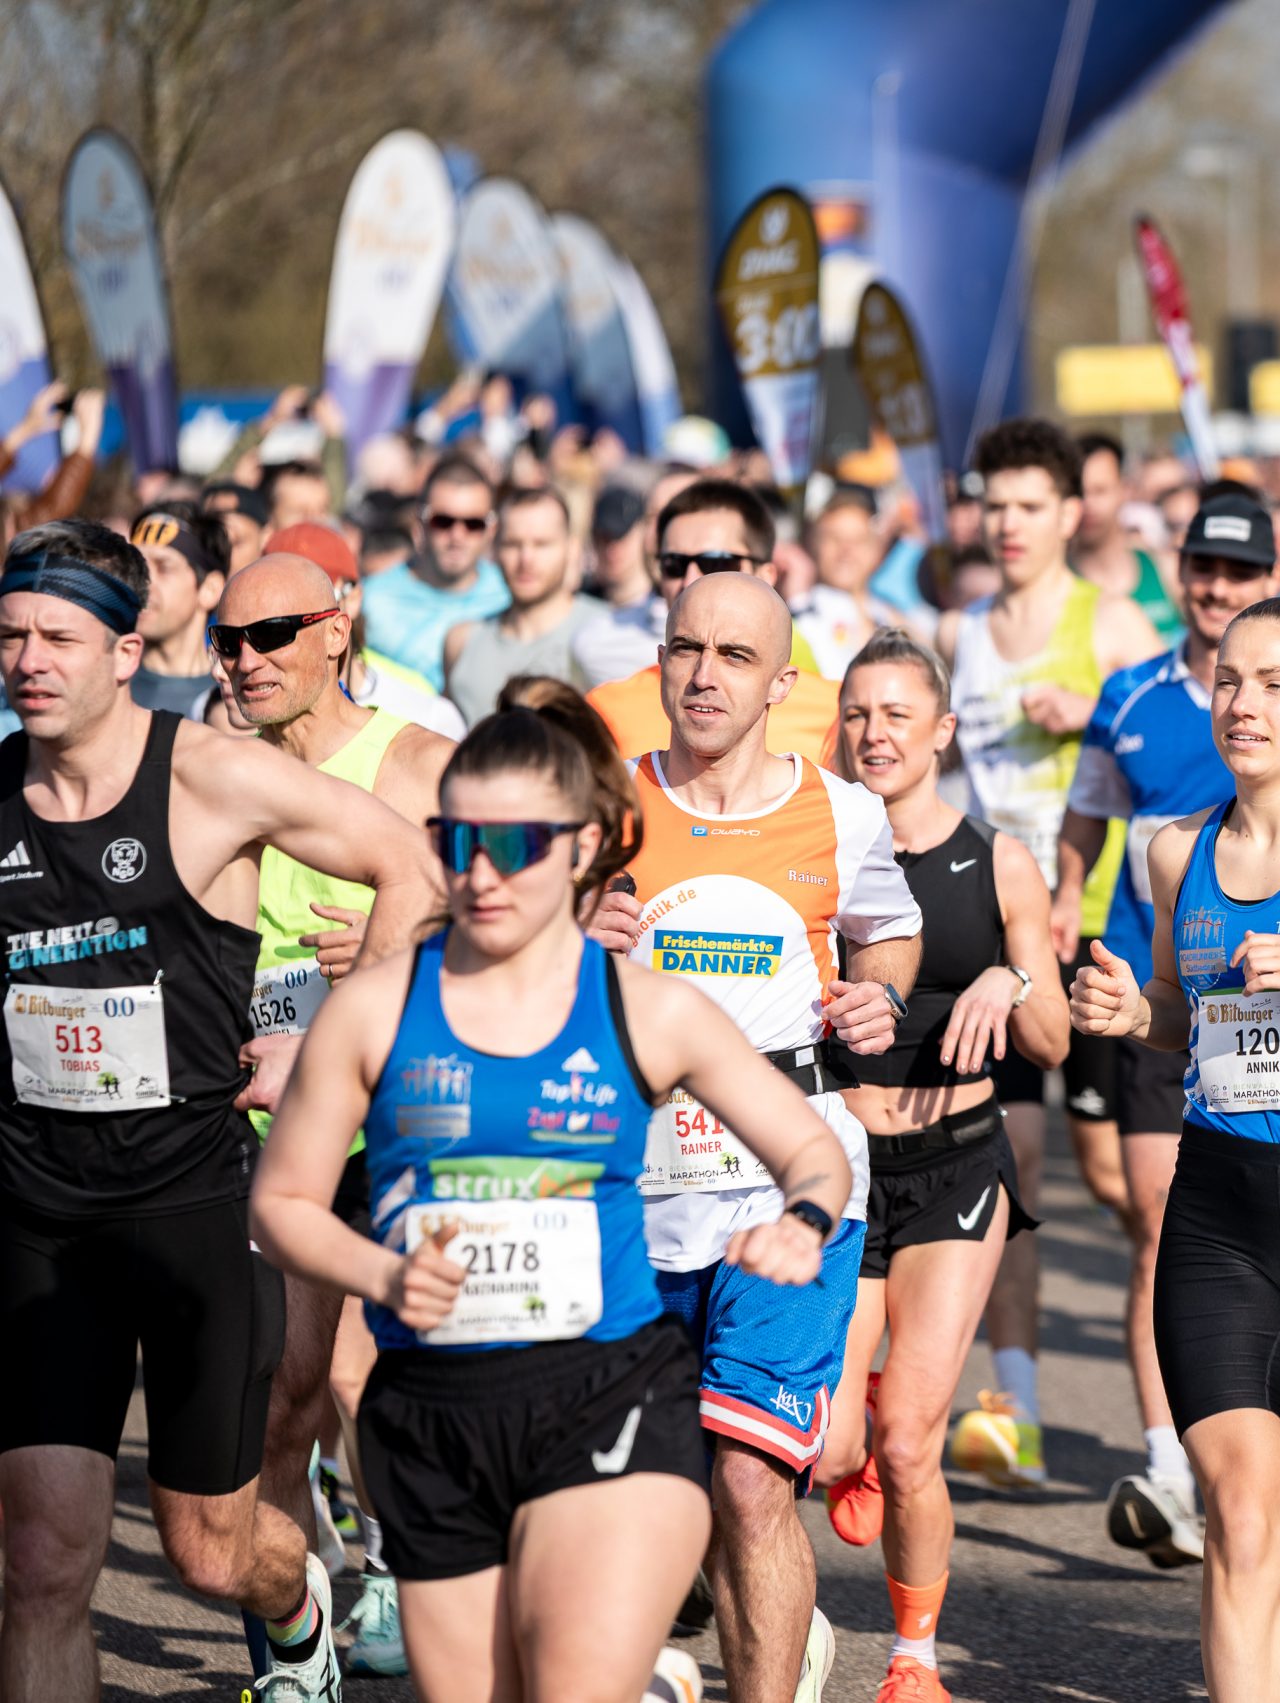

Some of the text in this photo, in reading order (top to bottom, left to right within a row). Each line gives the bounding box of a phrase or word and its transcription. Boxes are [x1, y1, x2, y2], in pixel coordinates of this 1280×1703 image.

[788, 869, 828, 887] Rainer
[662, 934, 775, 953] Frischemärkte
[661, 951, 772, 976] DANNER
[285, 968, 308, 989] 0.0
[28, 994, 135, 1020] Bitburger 0.0
[250, 996, 296, 1029] 1526
[1220, 1003, 1273, 1024] Bitburger
[55, 1025, 102, 1053] 513
[60, 1059, 100, 1072] TOBIAS
[540, 1078, 618, 1107] Top Life
[675, 1108, 724, 1138] 541
[681, 1141, 722, 1156] RAINER
[669, 1169, 719, 1180] MARATHON
[462, 1242, 540, 1275] 2178
